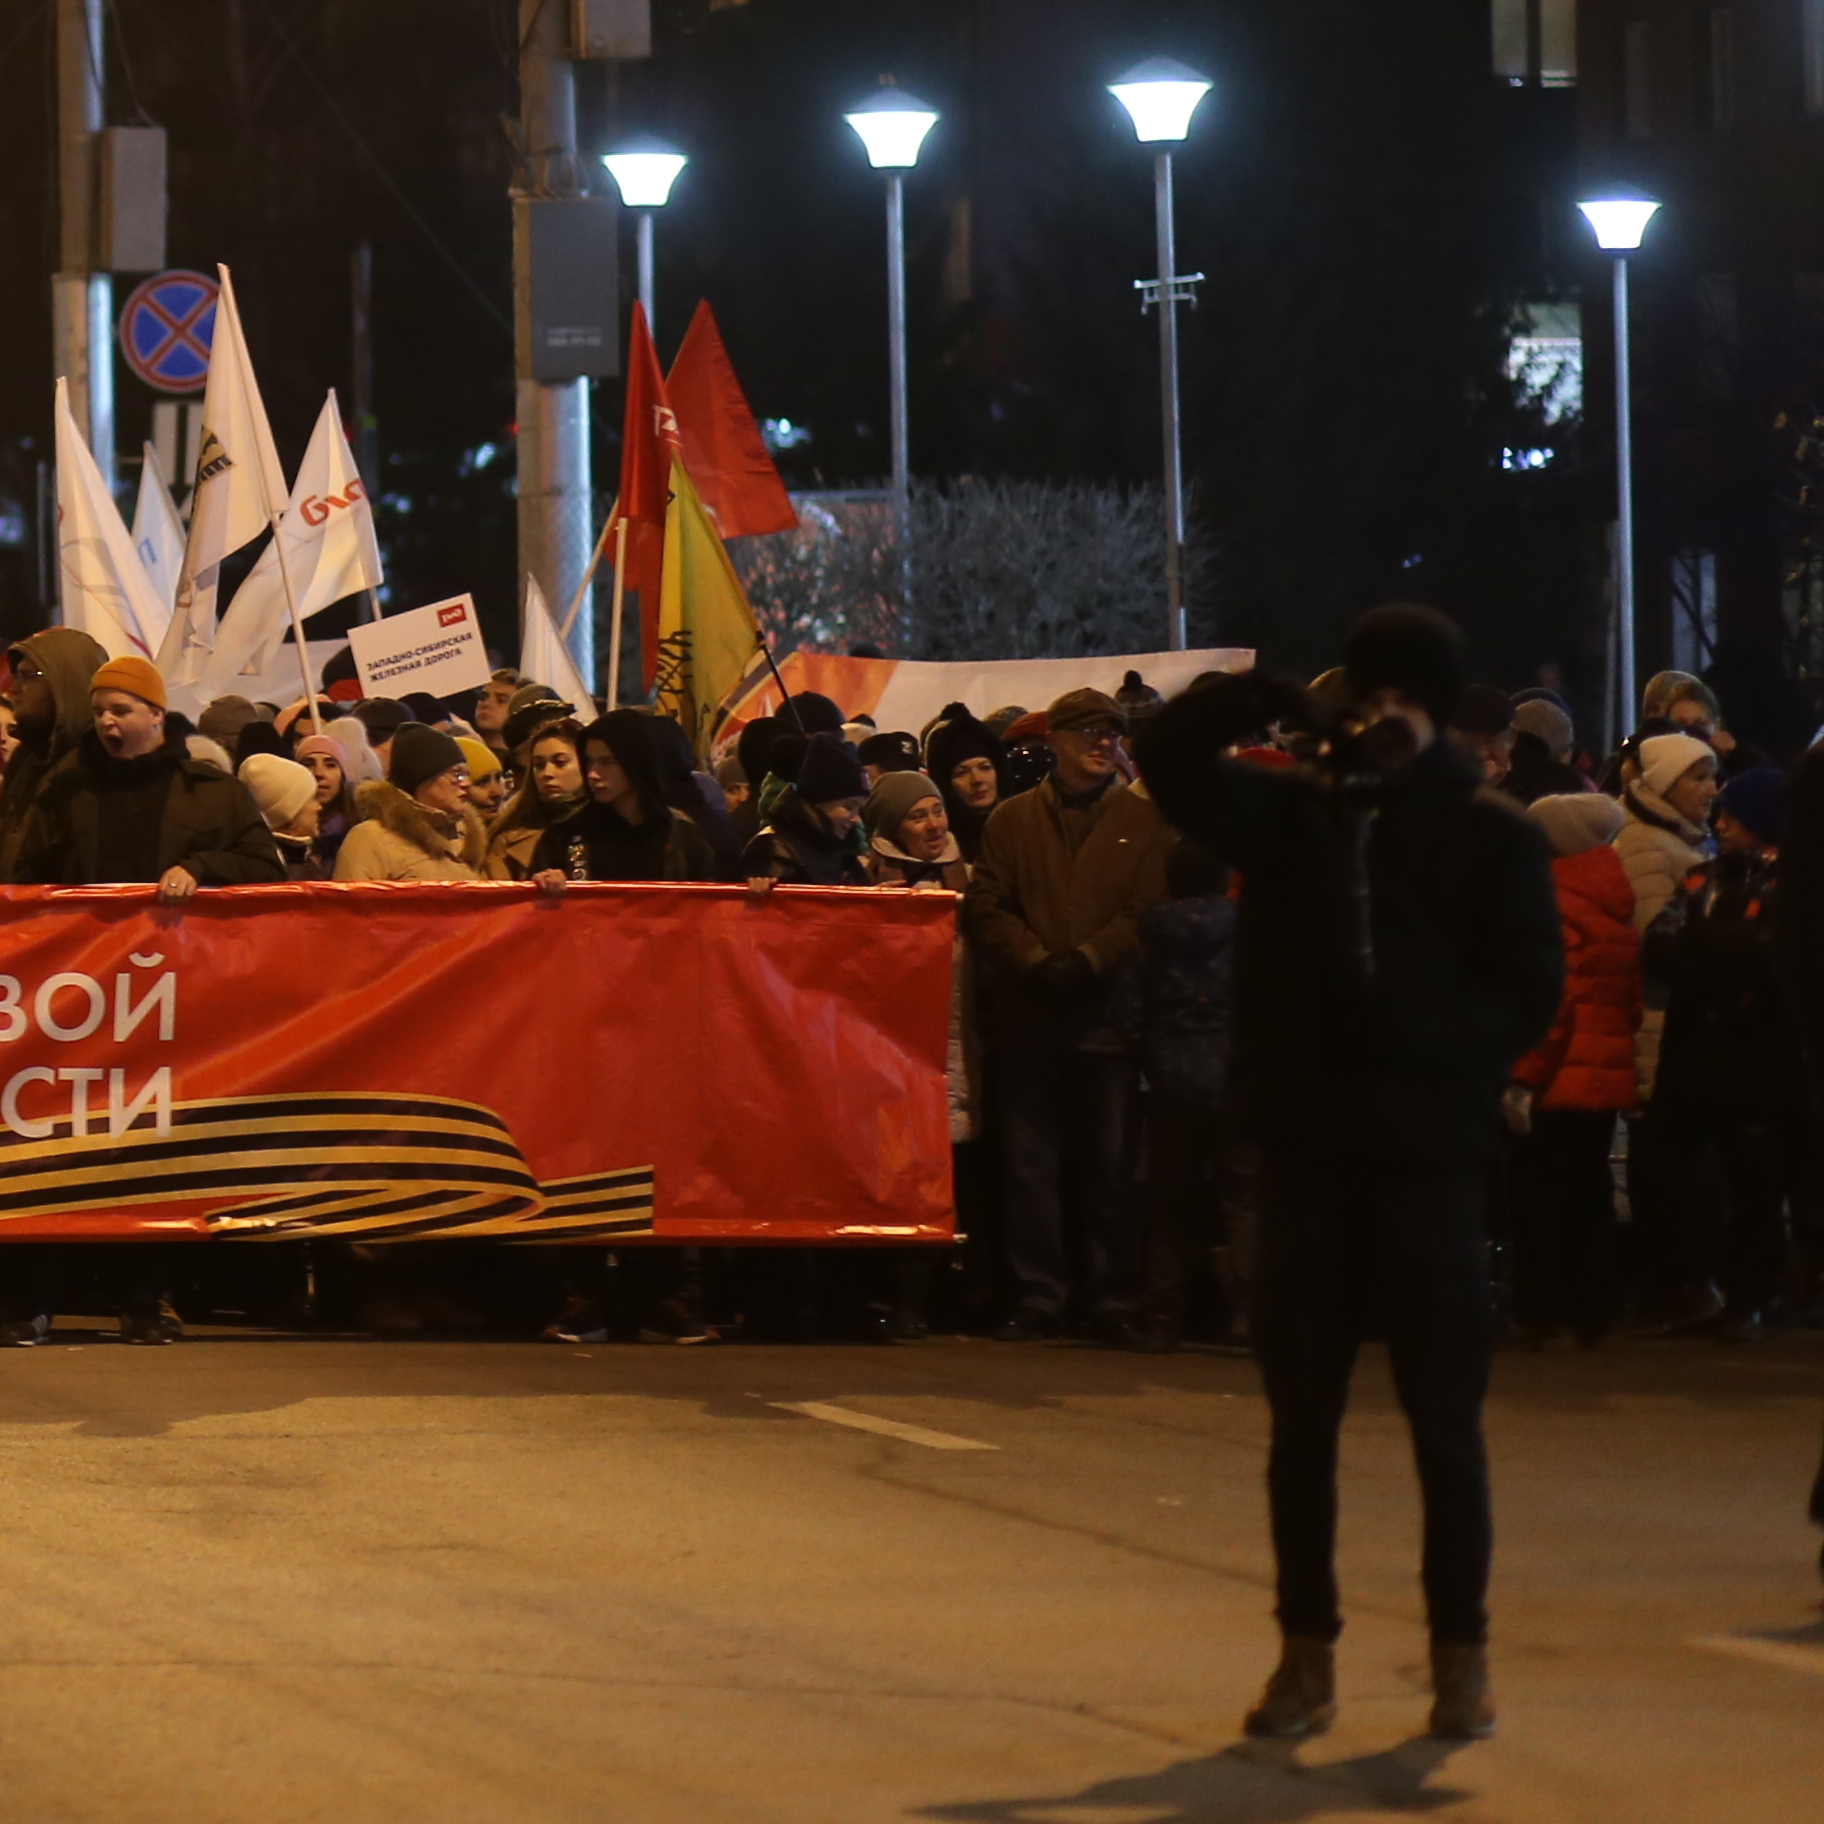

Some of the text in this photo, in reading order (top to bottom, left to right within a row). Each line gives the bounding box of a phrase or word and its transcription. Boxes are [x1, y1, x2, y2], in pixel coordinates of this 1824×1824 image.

[367, 632, 472, 672] ЗАПАДНО-СИБИРСКАЯ
[370, 647, 463, 682] ЖЕЛЕЗНАЯ ДОРОГА
